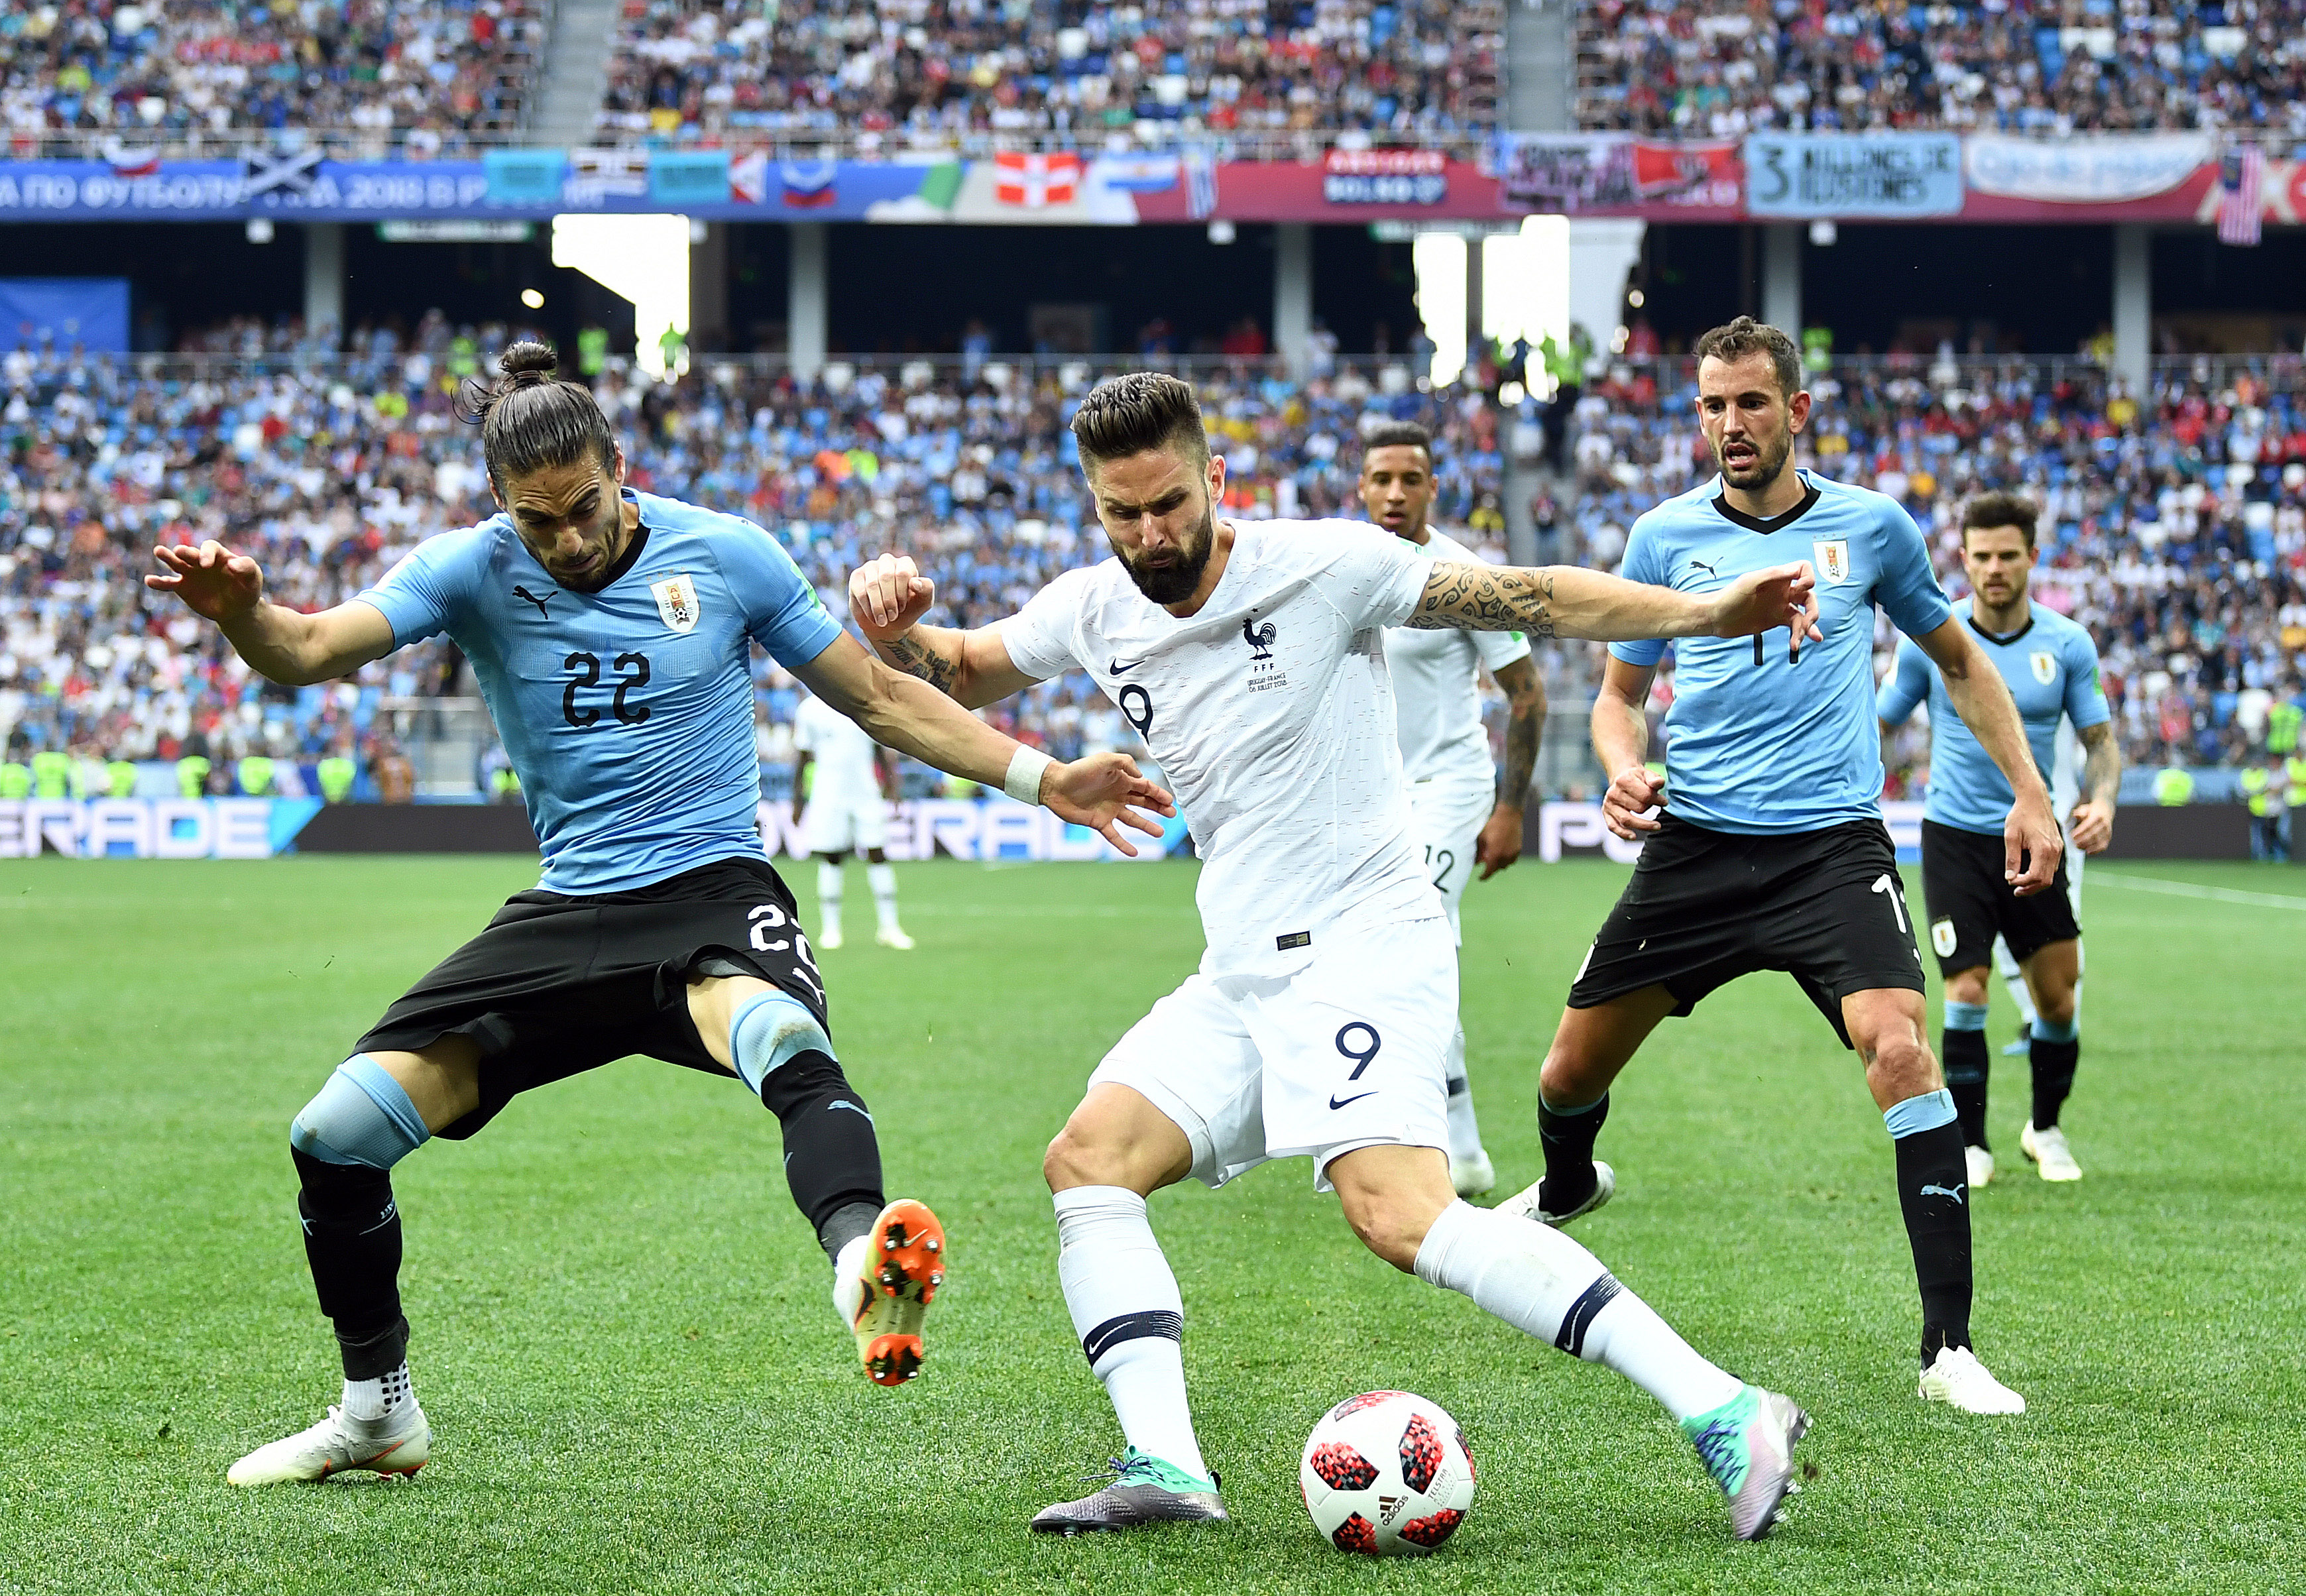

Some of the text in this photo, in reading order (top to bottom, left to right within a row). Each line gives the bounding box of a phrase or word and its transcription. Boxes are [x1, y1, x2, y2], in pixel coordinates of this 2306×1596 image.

[563, 652, 651, 727] 22
[1119, 684, 1153, 746] 9
[1335, 1021, 1381, 1081] 9
[1382, 1495, 1409, 1526] adidas
